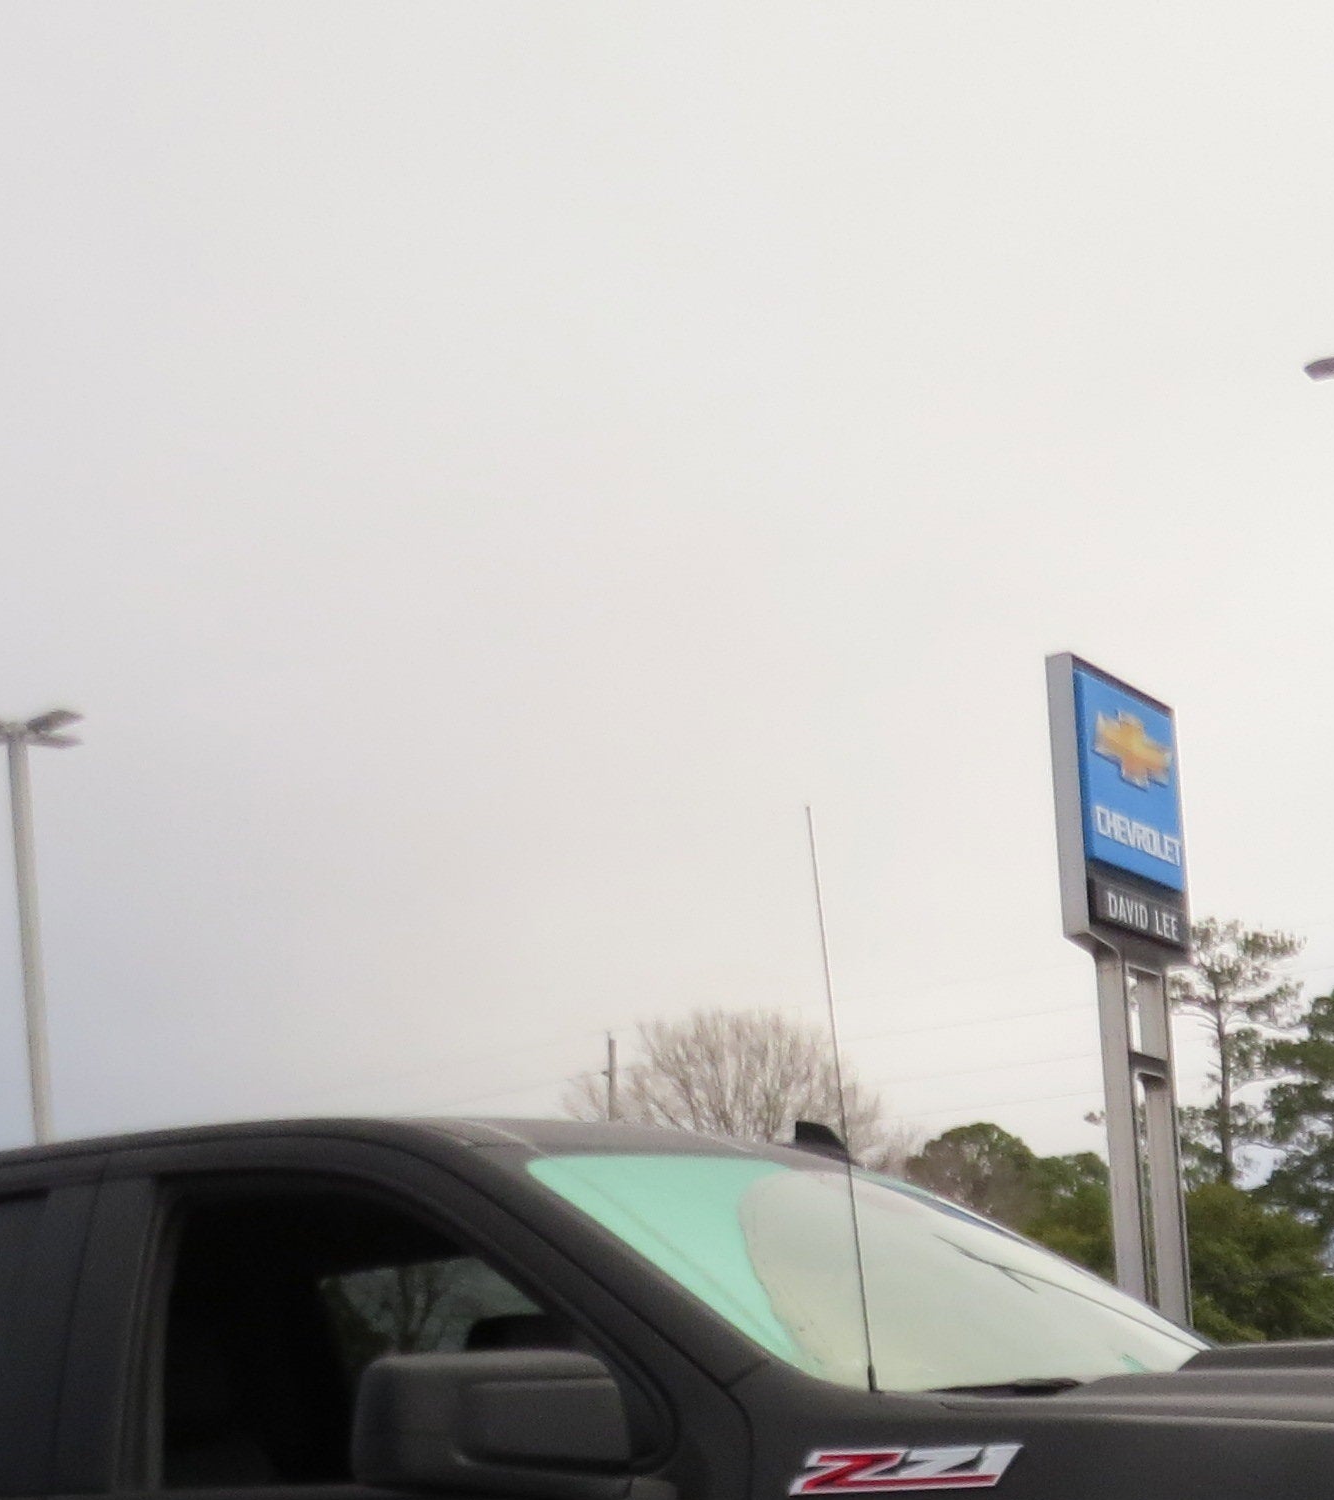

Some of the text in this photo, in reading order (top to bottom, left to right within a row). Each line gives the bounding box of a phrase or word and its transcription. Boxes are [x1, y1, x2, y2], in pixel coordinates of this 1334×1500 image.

[1095, 805, 1181, 867] CHEVROLET
[1108, 890, 1180, 942] DAVID LEE
[787, 1443, 1024, 1497] Z71
